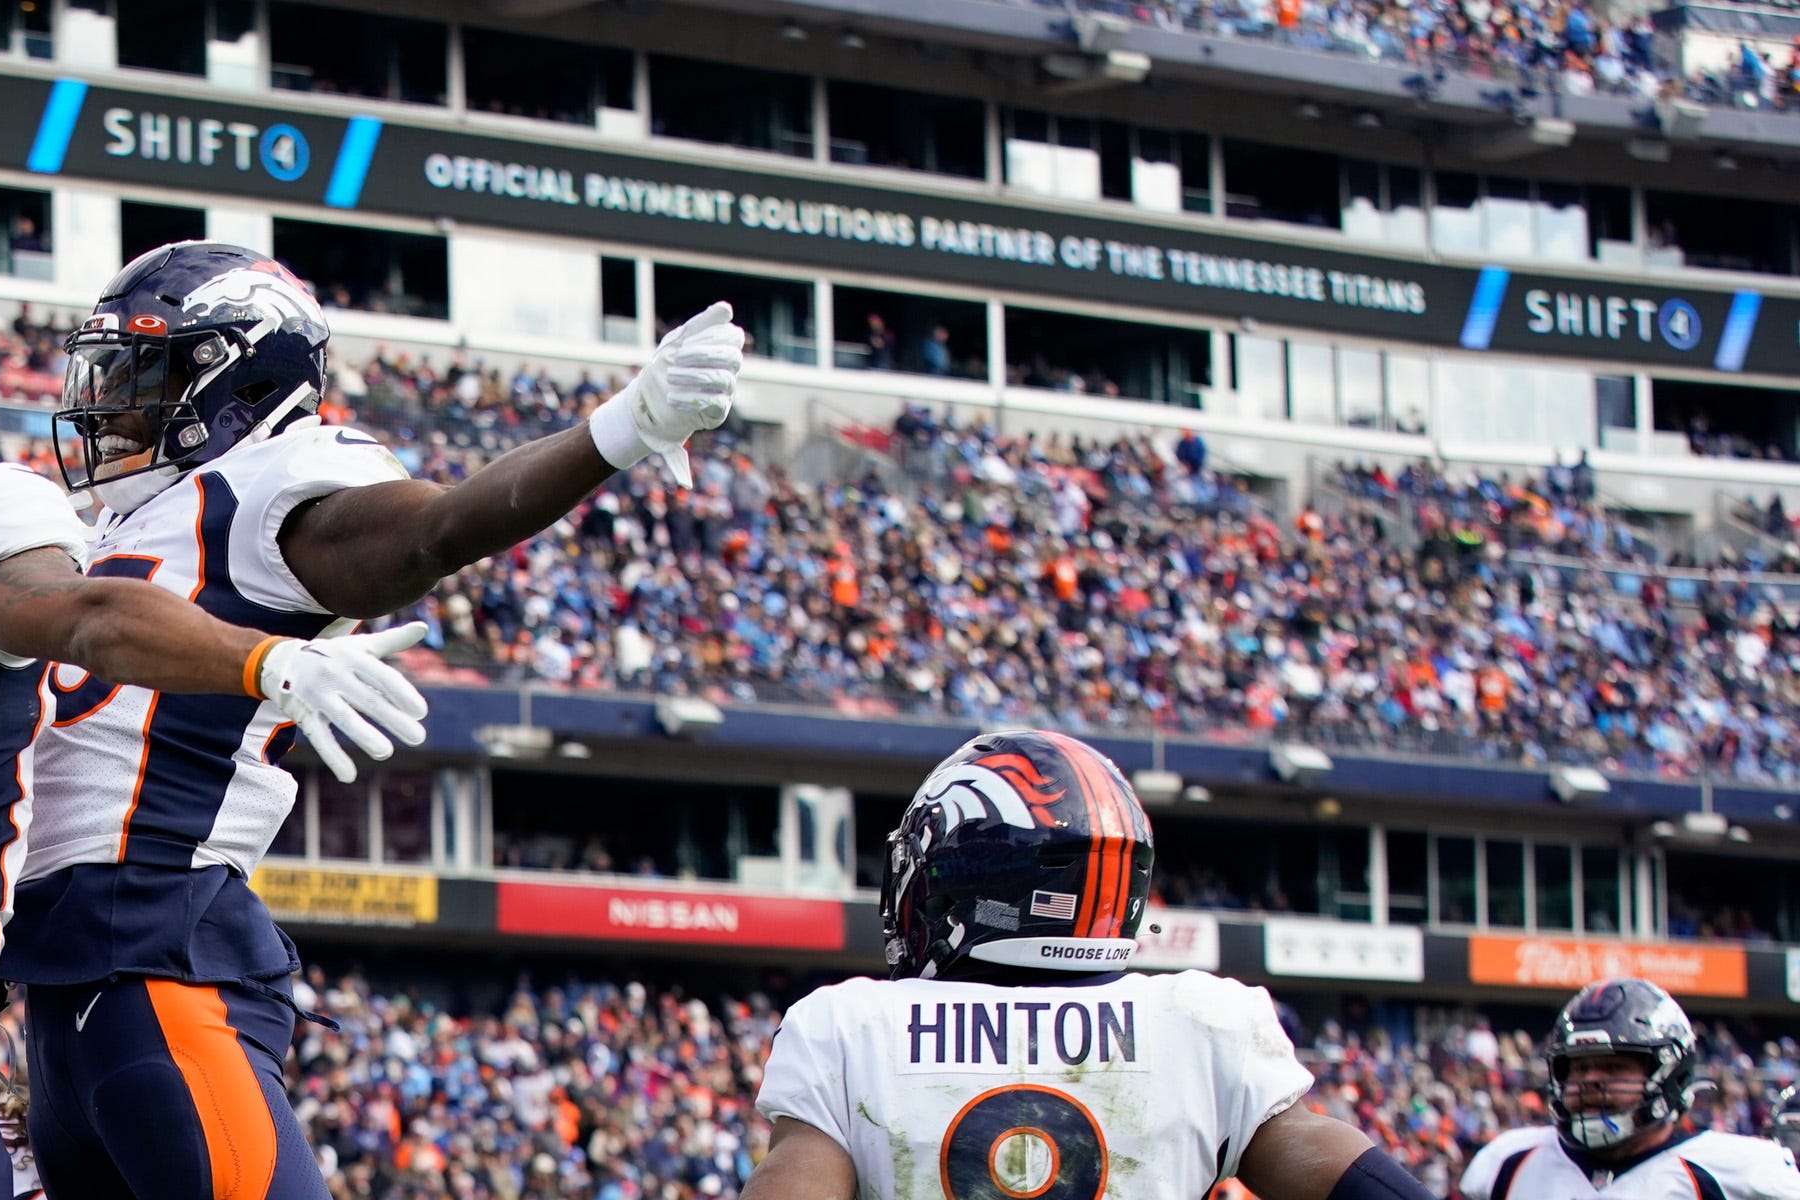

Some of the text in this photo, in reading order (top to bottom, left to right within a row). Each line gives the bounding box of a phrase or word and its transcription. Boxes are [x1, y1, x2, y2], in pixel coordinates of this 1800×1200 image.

[424, 152, 1428, 315] OFFICIAL PAYMENT SOLUTIONS PARTNER OF THE TENNESSEE TITANS
[608, 896, 739, 932] NISSAN
[1129, 899, 1141, 920] 9
[1041, 945, 1131, 960] CHOOSE LOVE
[907, 1001, 1137, 1066] HINTON
